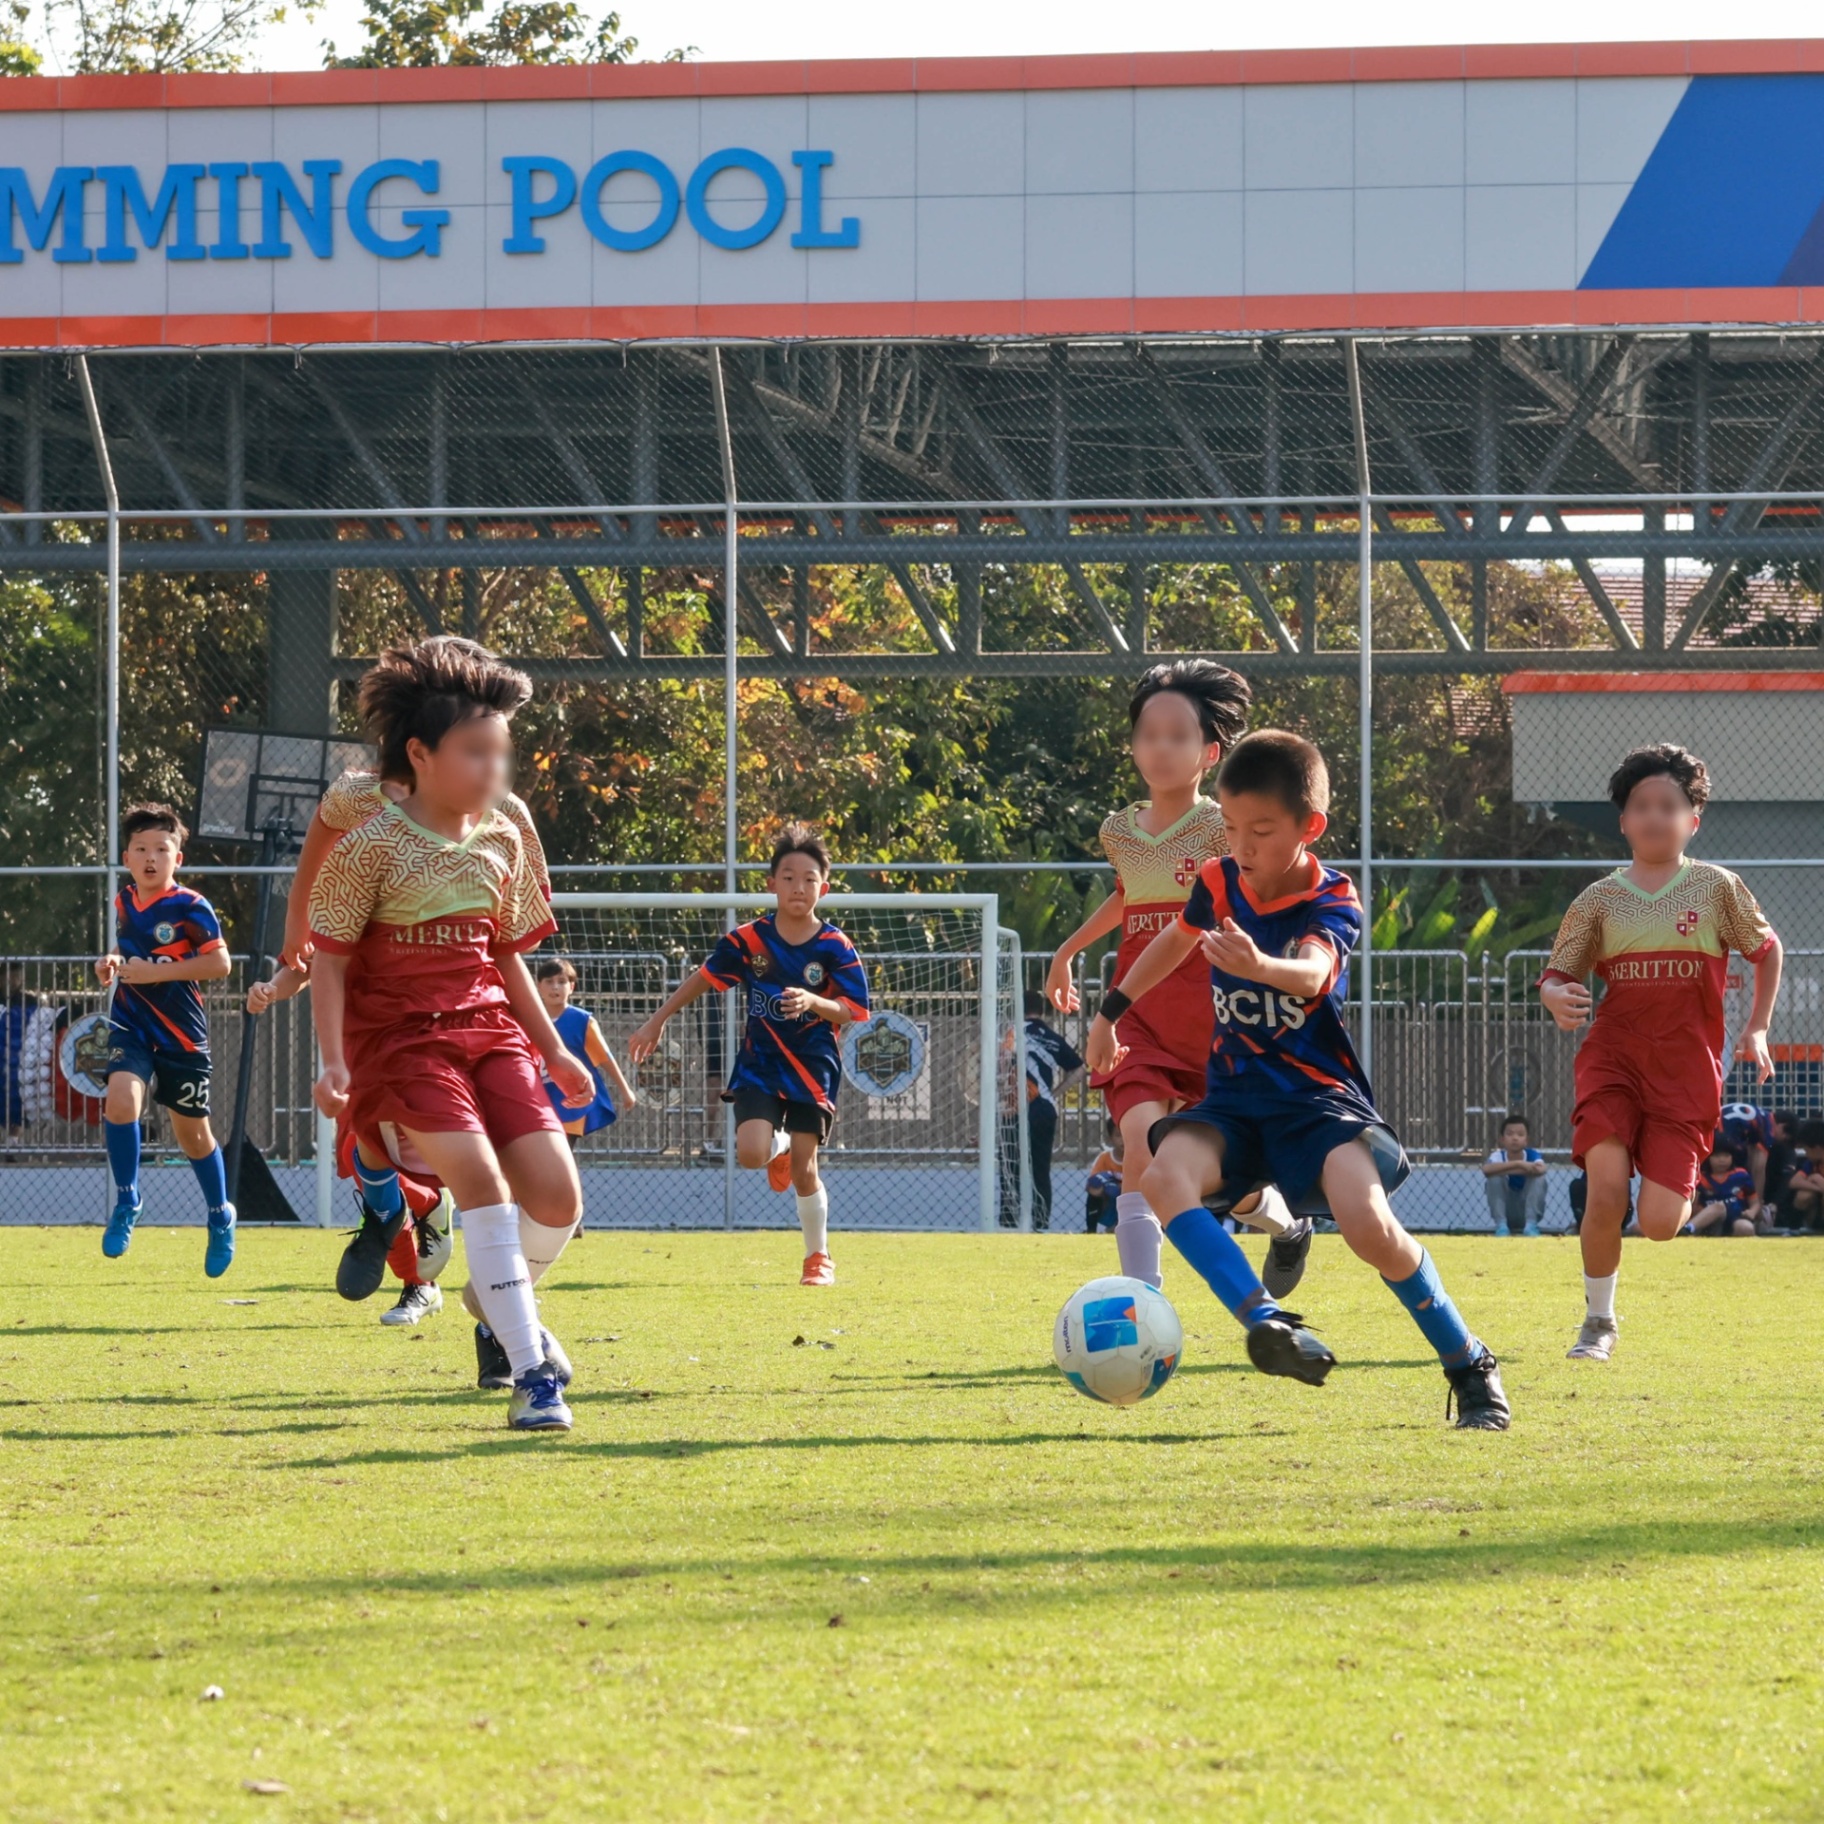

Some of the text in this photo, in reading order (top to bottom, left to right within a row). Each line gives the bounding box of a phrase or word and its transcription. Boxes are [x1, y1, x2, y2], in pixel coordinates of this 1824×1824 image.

[503, 147, 860, 253] POOL
[1607, 959, 1704, 981] MERITTON
[1211, 984, 1306, 1031] BCIS
[176, 1079, 210, 1109] 25
